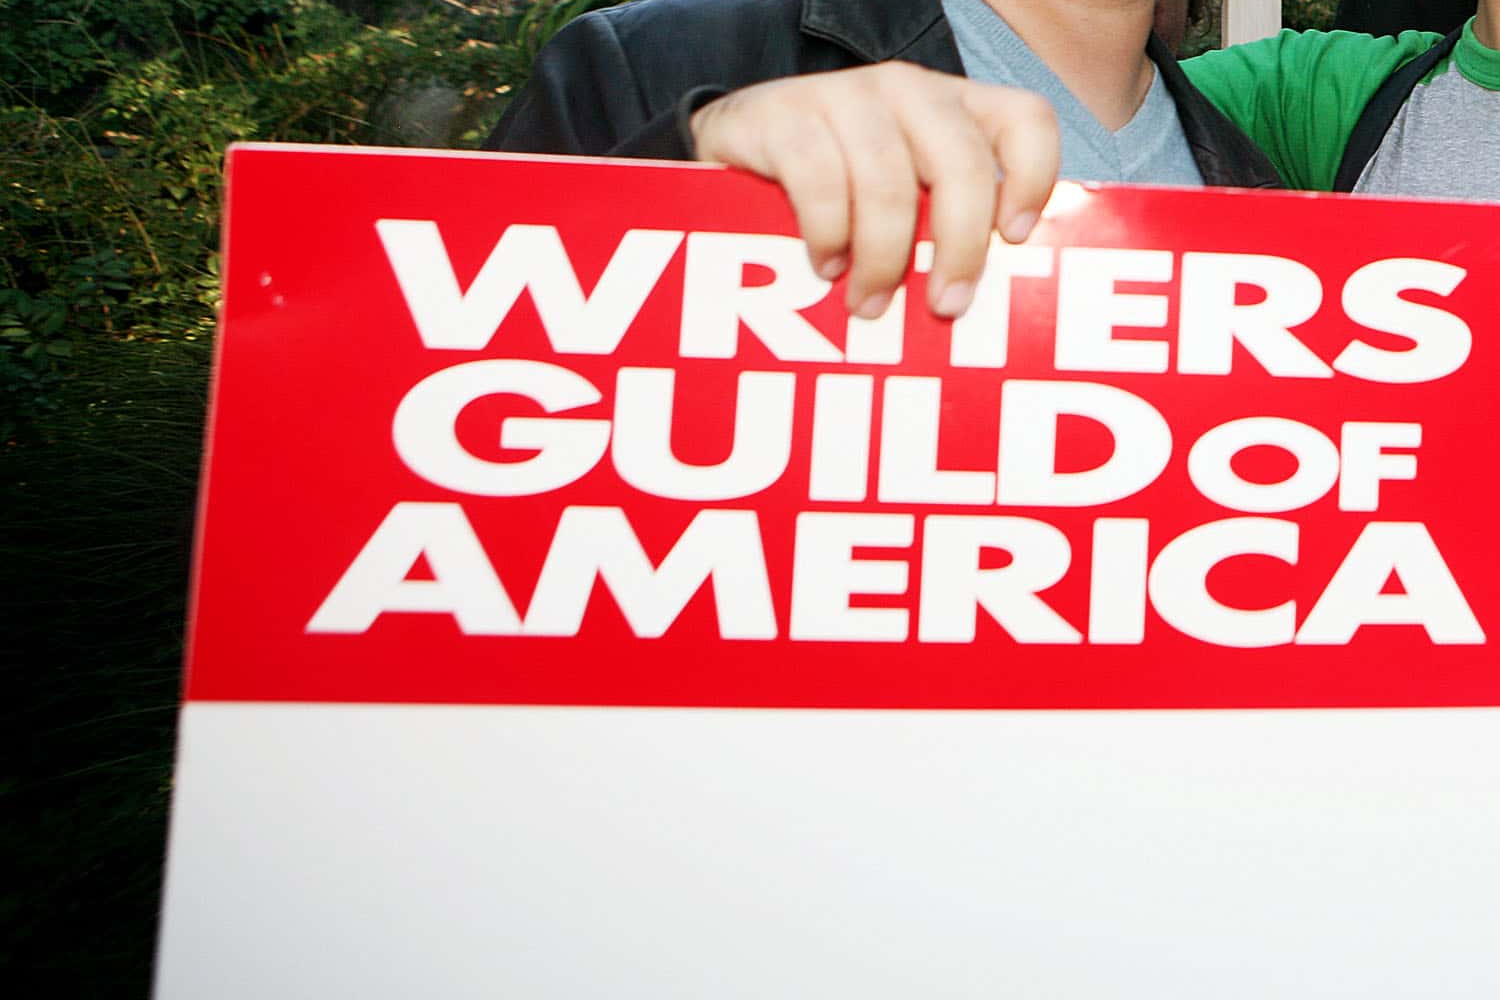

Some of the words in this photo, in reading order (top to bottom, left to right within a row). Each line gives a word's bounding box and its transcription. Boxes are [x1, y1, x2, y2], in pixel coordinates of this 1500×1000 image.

[375, 218, 1474, 384] WRITERS
[391, 358, 1174, 509] GUILD
[1187, 416, 1424, 514] OF
[305, 501, 1488, 650] AMERICA
